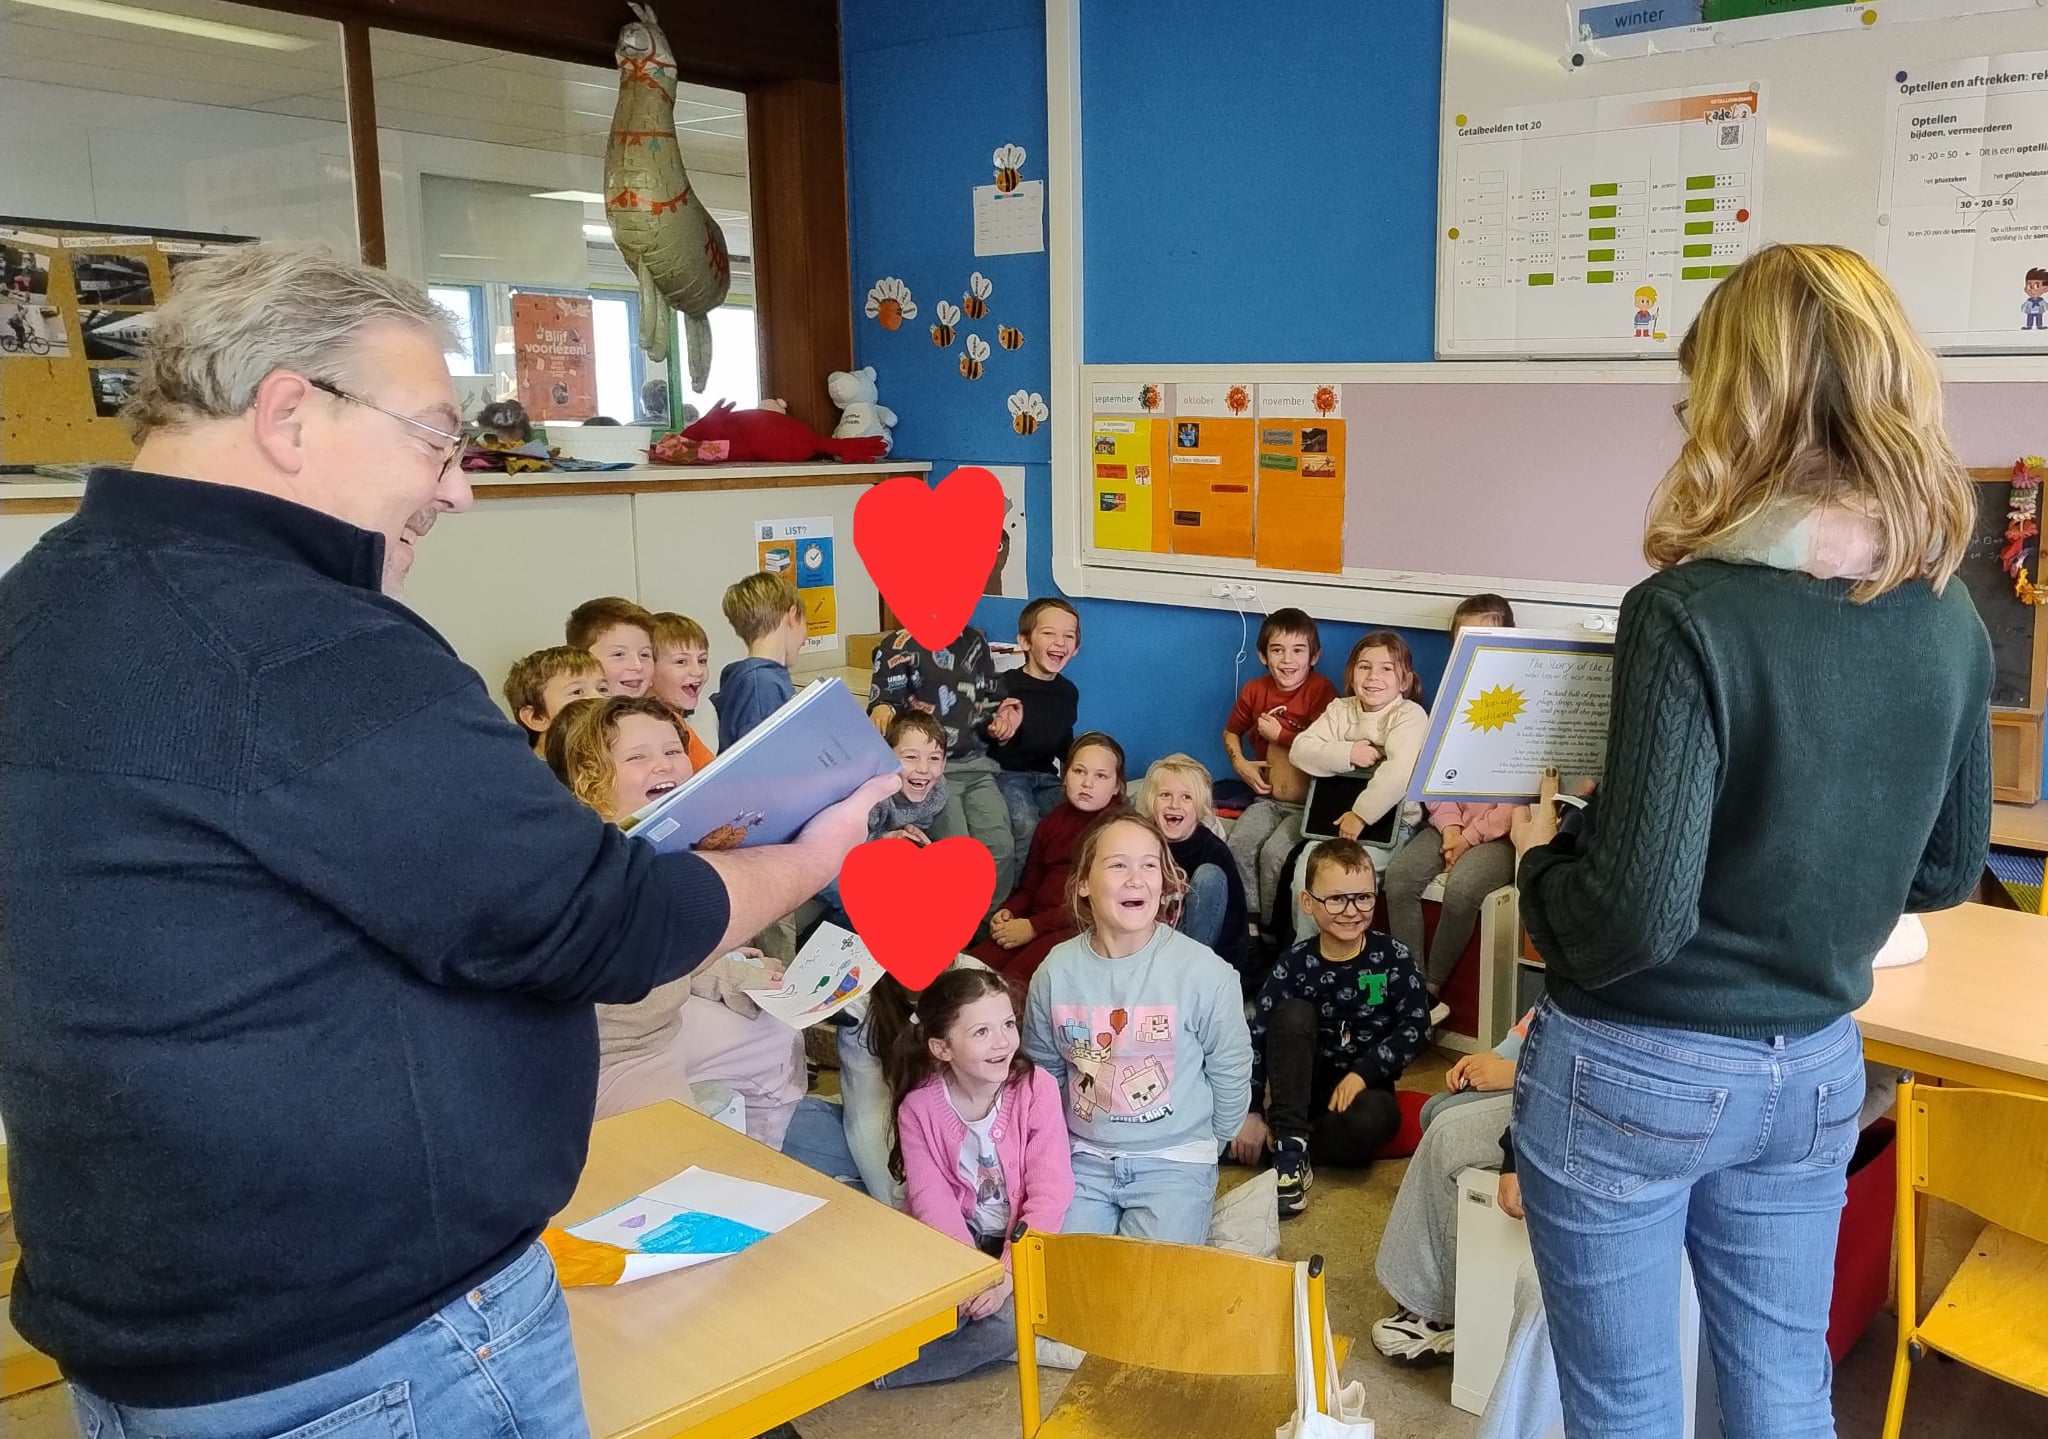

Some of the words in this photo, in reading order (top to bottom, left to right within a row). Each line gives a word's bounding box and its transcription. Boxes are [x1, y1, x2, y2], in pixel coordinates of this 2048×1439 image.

[1614, 9, 1665, 28] winter
[1900, 80, 1948, 96] Optellen
[1950, 80, 1965, 89] en
[1966, 71, 2029, 88] aftrekken:
[1741, 110, 1748, 119] 2
[1911, 114, 1957, 128] Optellen
[1458, 122, 1515, 137] Getalbeelden
[1514, 122, 1529, 132] tot
[1530, 120, 1542, 131] 20
[1910, 129, 1946, 140] bijdoen,
[1948, 122, 2013, 136] vermeerderen
[1908, 153, 1919, 162] 30
[1928, 151, 1939, 161] 20
[1947, 150, 1958, 159] 50
[1979, 148, 1991, 157] Dit
[1999, 146, 2015, 155] een
[1960, 200, 1972, 209] 30
[1981, 199, 1993, 208] 20
[2002, 198, 2014, 206] 50
[545, 329, 568, 345] Blijf
[525, 343, 587, 356] voorlezen!
[1094, 395, 1134, 406] september
[1184, 395, 1214, 406] oktober
[1262, 396, 1306, 406] november
[785, 526, 807, 536] LIST?
[1529, 658, 1544, 669] The
[1550, 659, 1575, 674] Story
[1576, 660, 1588, 671] of
[1589, 660, 1603, 672] the
[1358, 973, 1387, 1005] T
[1109, 1102, 1175, 1124] MINECRAFT
